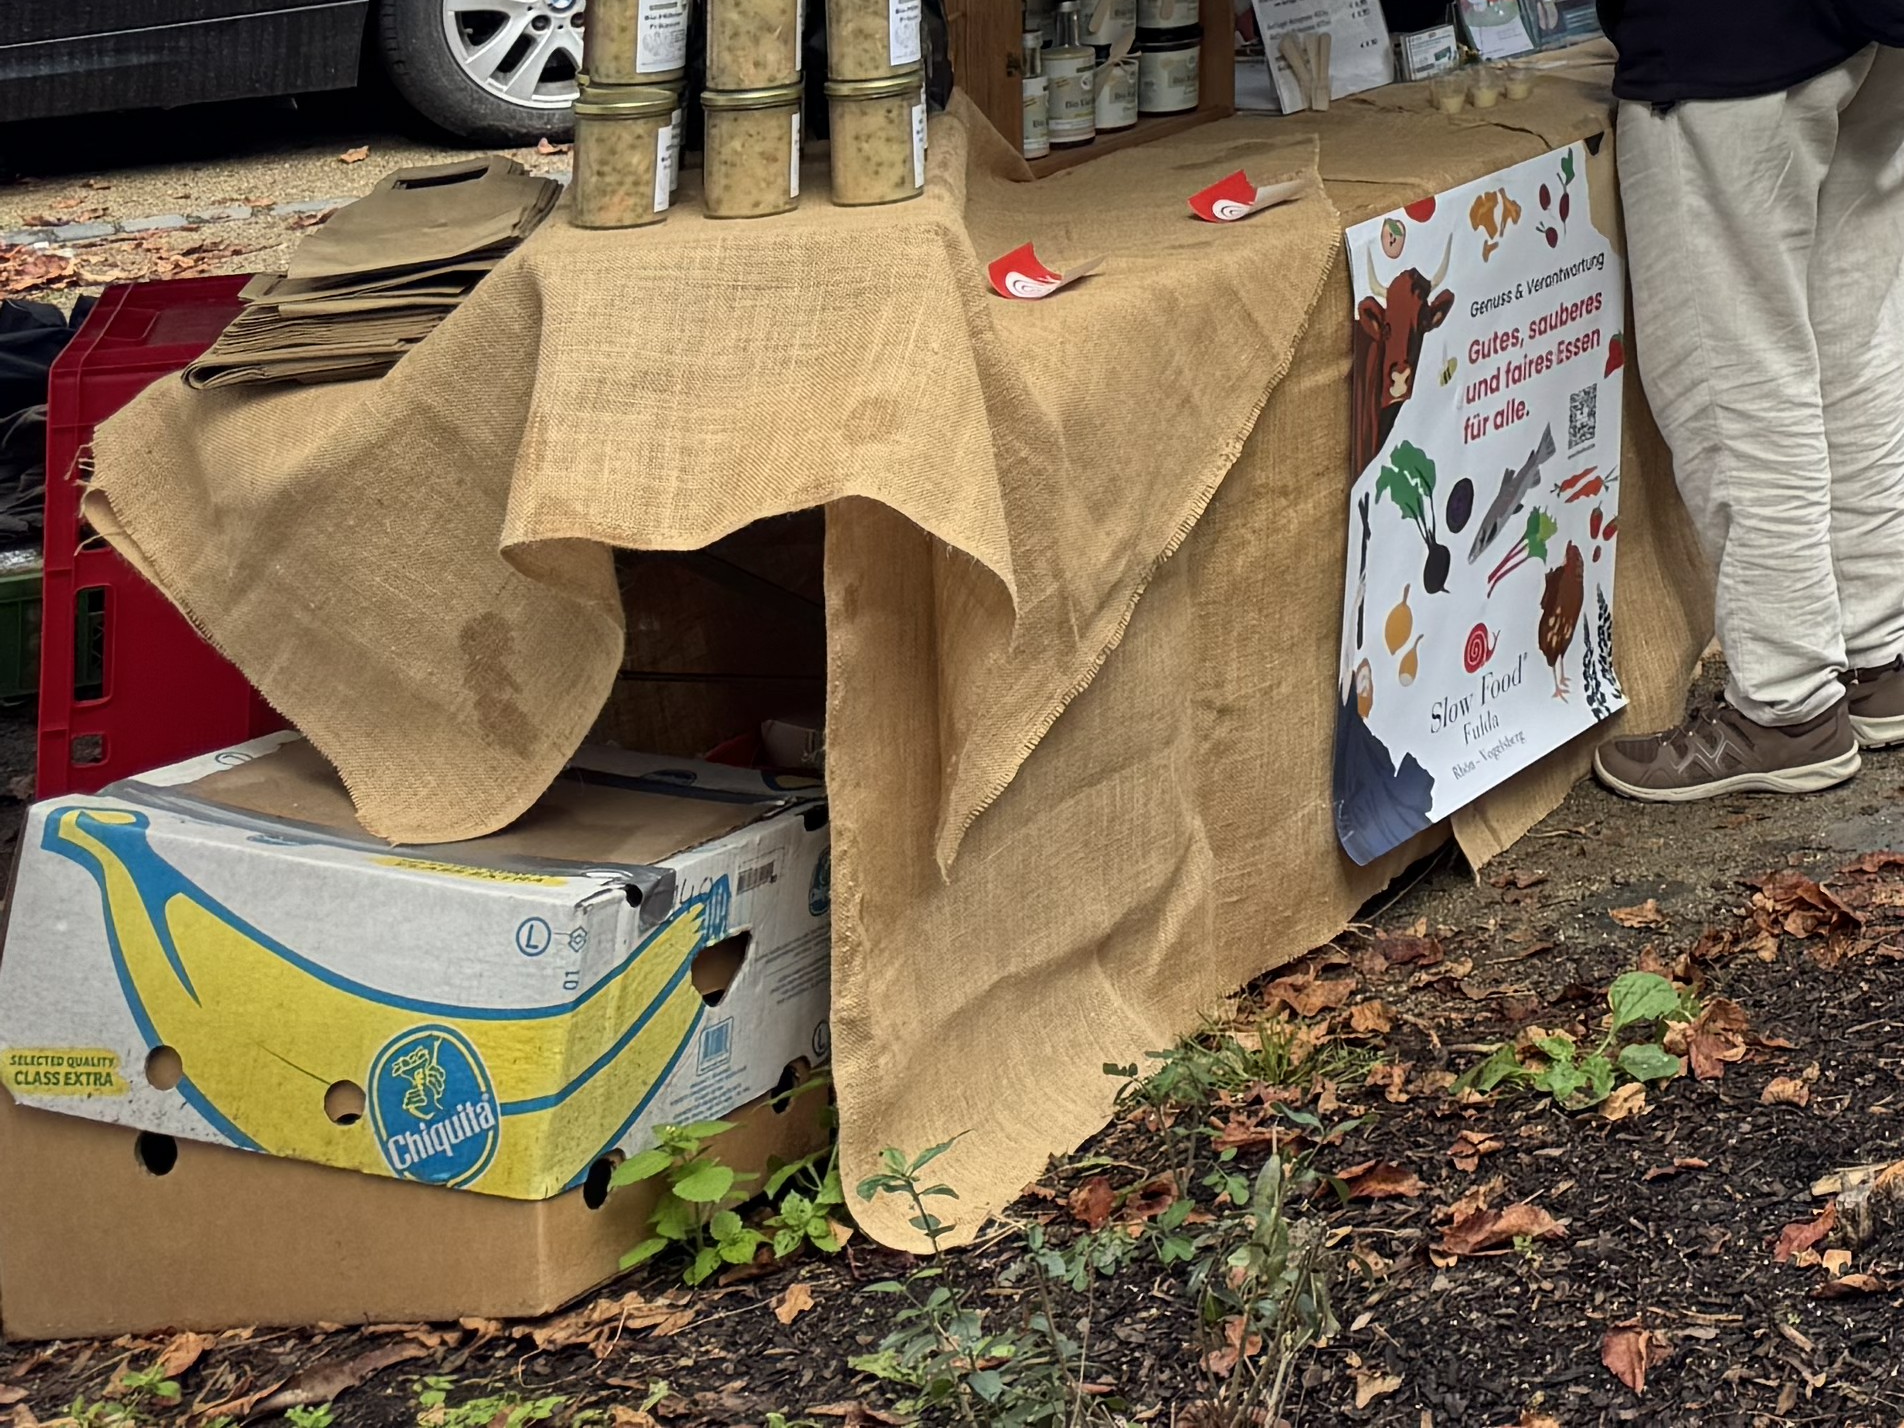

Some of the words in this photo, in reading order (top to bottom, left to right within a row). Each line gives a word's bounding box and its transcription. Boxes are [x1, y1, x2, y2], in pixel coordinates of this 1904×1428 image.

[1470, 289, 1512, 318] Genuss
[1514, 283, 1524, 300] &
[1526, 252, 1605, 296] Verantwortung
[1468, 328, 1525, 365] Gutes,
[1528, 292, 1603, 340] sauberes
[1465, 367, 1501, 405] und
[1504, 353, 1554, 389] faires
[1556, 328, 1601, 365] Essen
[1464, 413, 1490, 444] für
[1493, 398, 1531, 431] alle.
[1430, 693, 1473, 734] Slow
[1463, 709, 1500, 745] Fulda
[10, 1054, 65, 1067] SELECTED
[67, 1055, 114, 1068] QUALITY
[14, 1070, 60, 1086] CLASS
[64, 1071, 113, 1087] EXTRA
[388, 1101, 496, 1171] Chiquita
